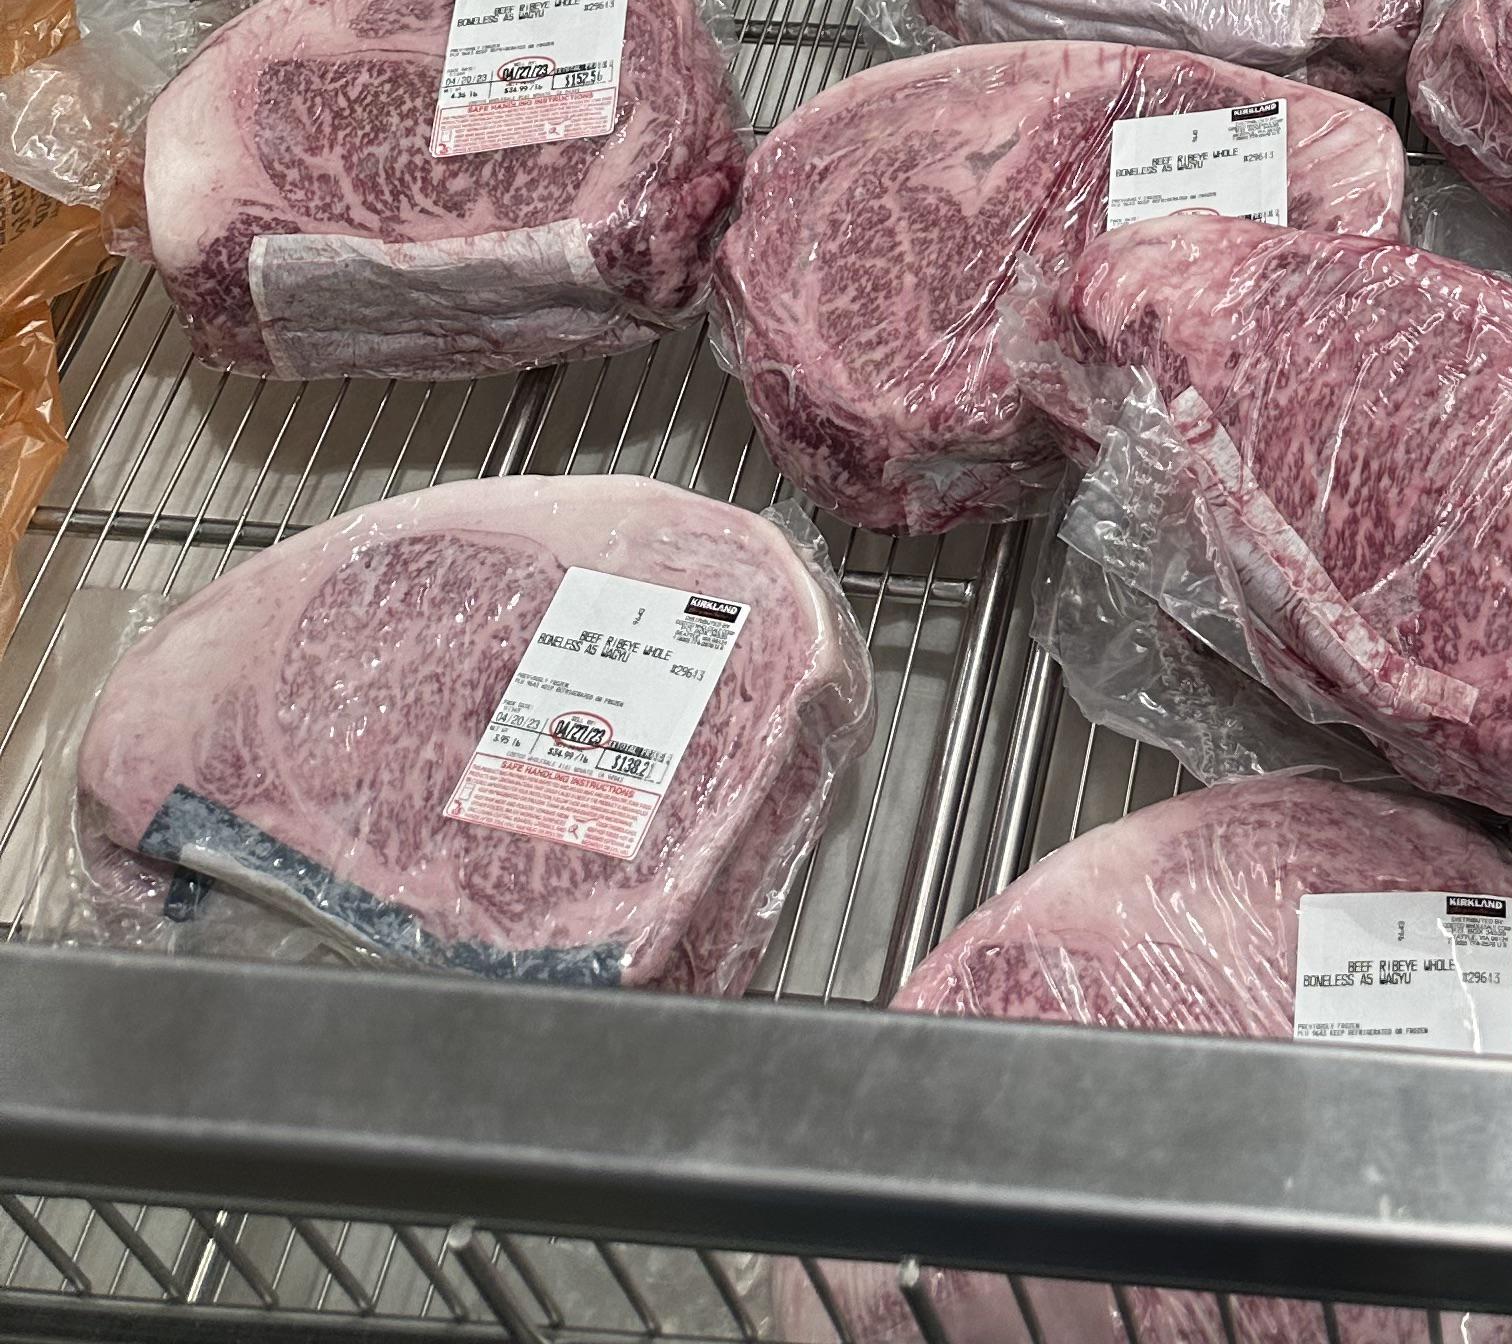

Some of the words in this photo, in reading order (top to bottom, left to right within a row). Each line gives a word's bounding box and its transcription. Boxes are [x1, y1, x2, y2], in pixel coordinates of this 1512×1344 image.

[501, 63, 548, 81] 04/27/23
[1177, 152, 1208, 163] RIBEYE
[1212, 147, 1238, 158] WHOLE
[689, 597, 738, 615] KIRKLAND
[536, 632, 584, 652] BONELESS
[598, 646, 631, 663] WAGYU
[578, 630, 604, 645] BEEF
[604, 636, 641, 653] RIBEYE
[641, 644, 673, 661] WHOLE
[494, 710, 541, 730] 04/20/23
[551, 719, 606, 746] 04/27/23
[499, 759, 525, 772] SAFE
[523, 765, 570, 783] HANDLING
[569, 775, 635, 799] INSTRUCTIONS
[1448, 897, 1502, 909] KIRKLAND
[1347, 960, 1372, 974] BEEF
[1379, 959, 1417, 972] RIBEYE
[1423, 958, 1455, 971] WHOLE
[1303, 972, 1354, 988] BONELESS
[1379, 971, 1411, 985] WAGYU
